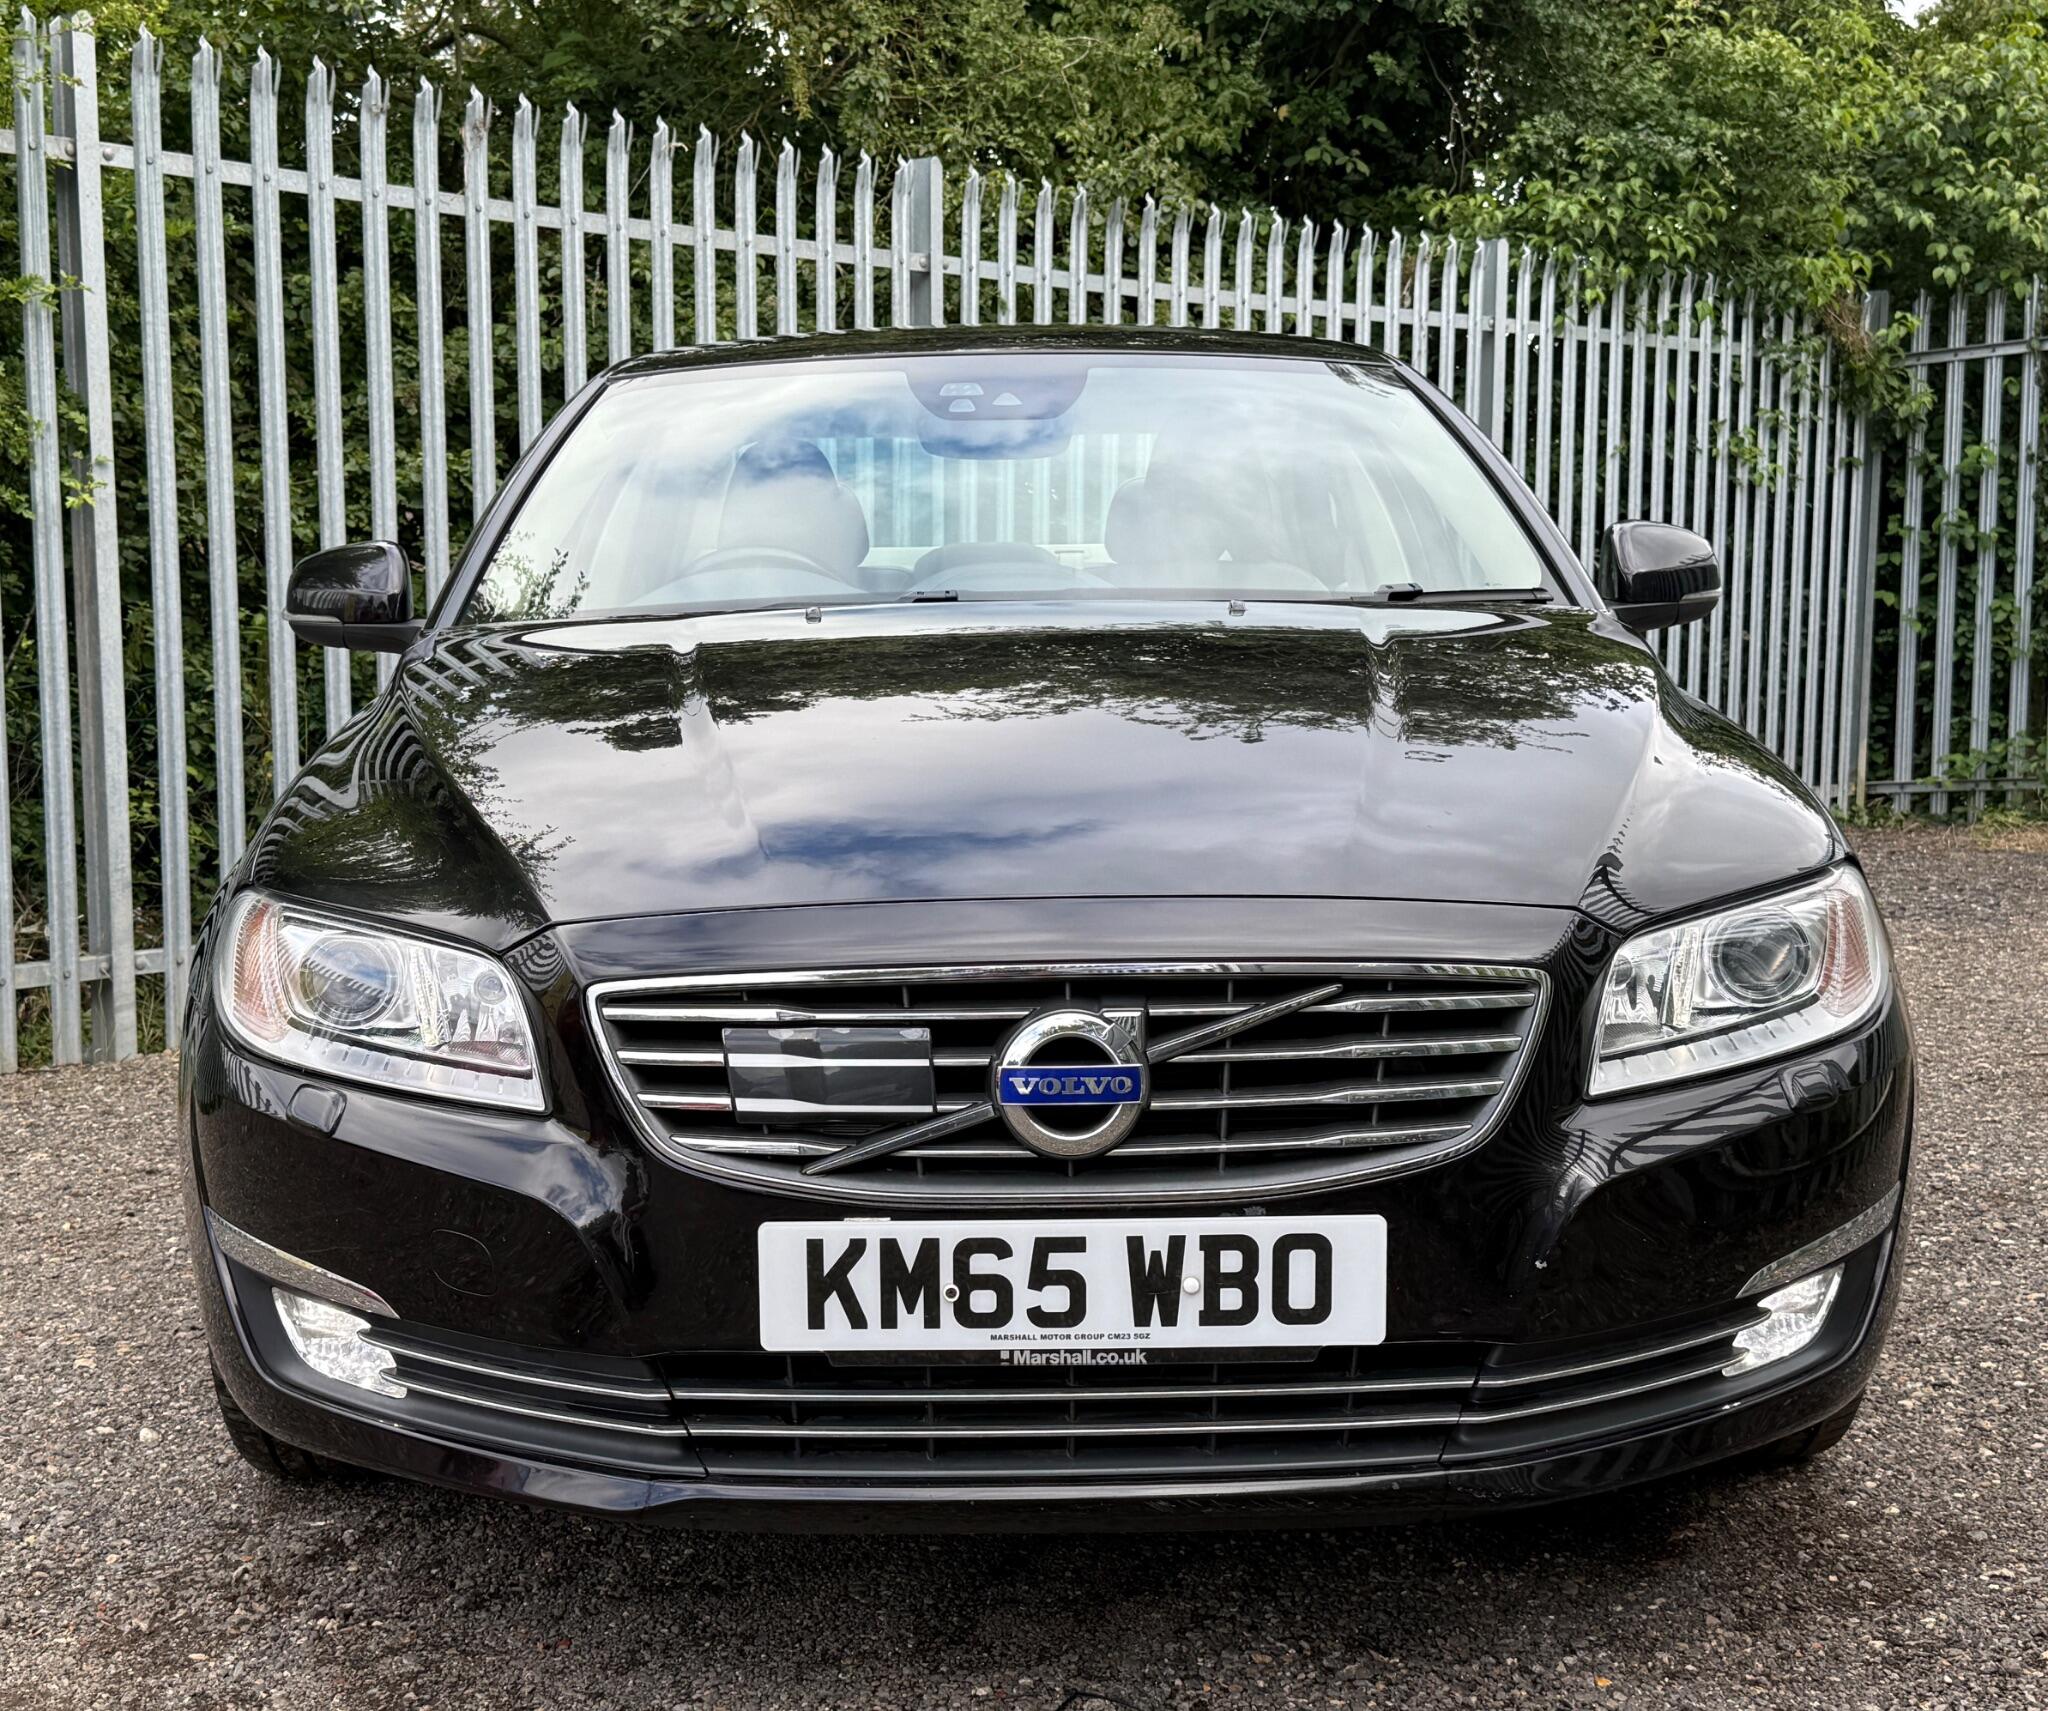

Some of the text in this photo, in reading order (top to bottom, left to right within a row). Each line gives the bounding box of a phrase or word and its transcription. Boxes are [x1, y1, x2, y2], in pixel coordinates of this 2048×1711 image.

[1009, 1076, 1133, 1095] VOLVO
[806, 1232, 1333, 1330] KM65 WBO
[990, 1333, 1038, 1341] MARSHALL
[1040, 1333, 1073, 1341] MOTOR
[1074, 1332, 1105, 1340] GROUP
[1107, 1332, 1131, 1340] CM23
[1013, 1349, 1147, 1365] Marshall.co.uk
